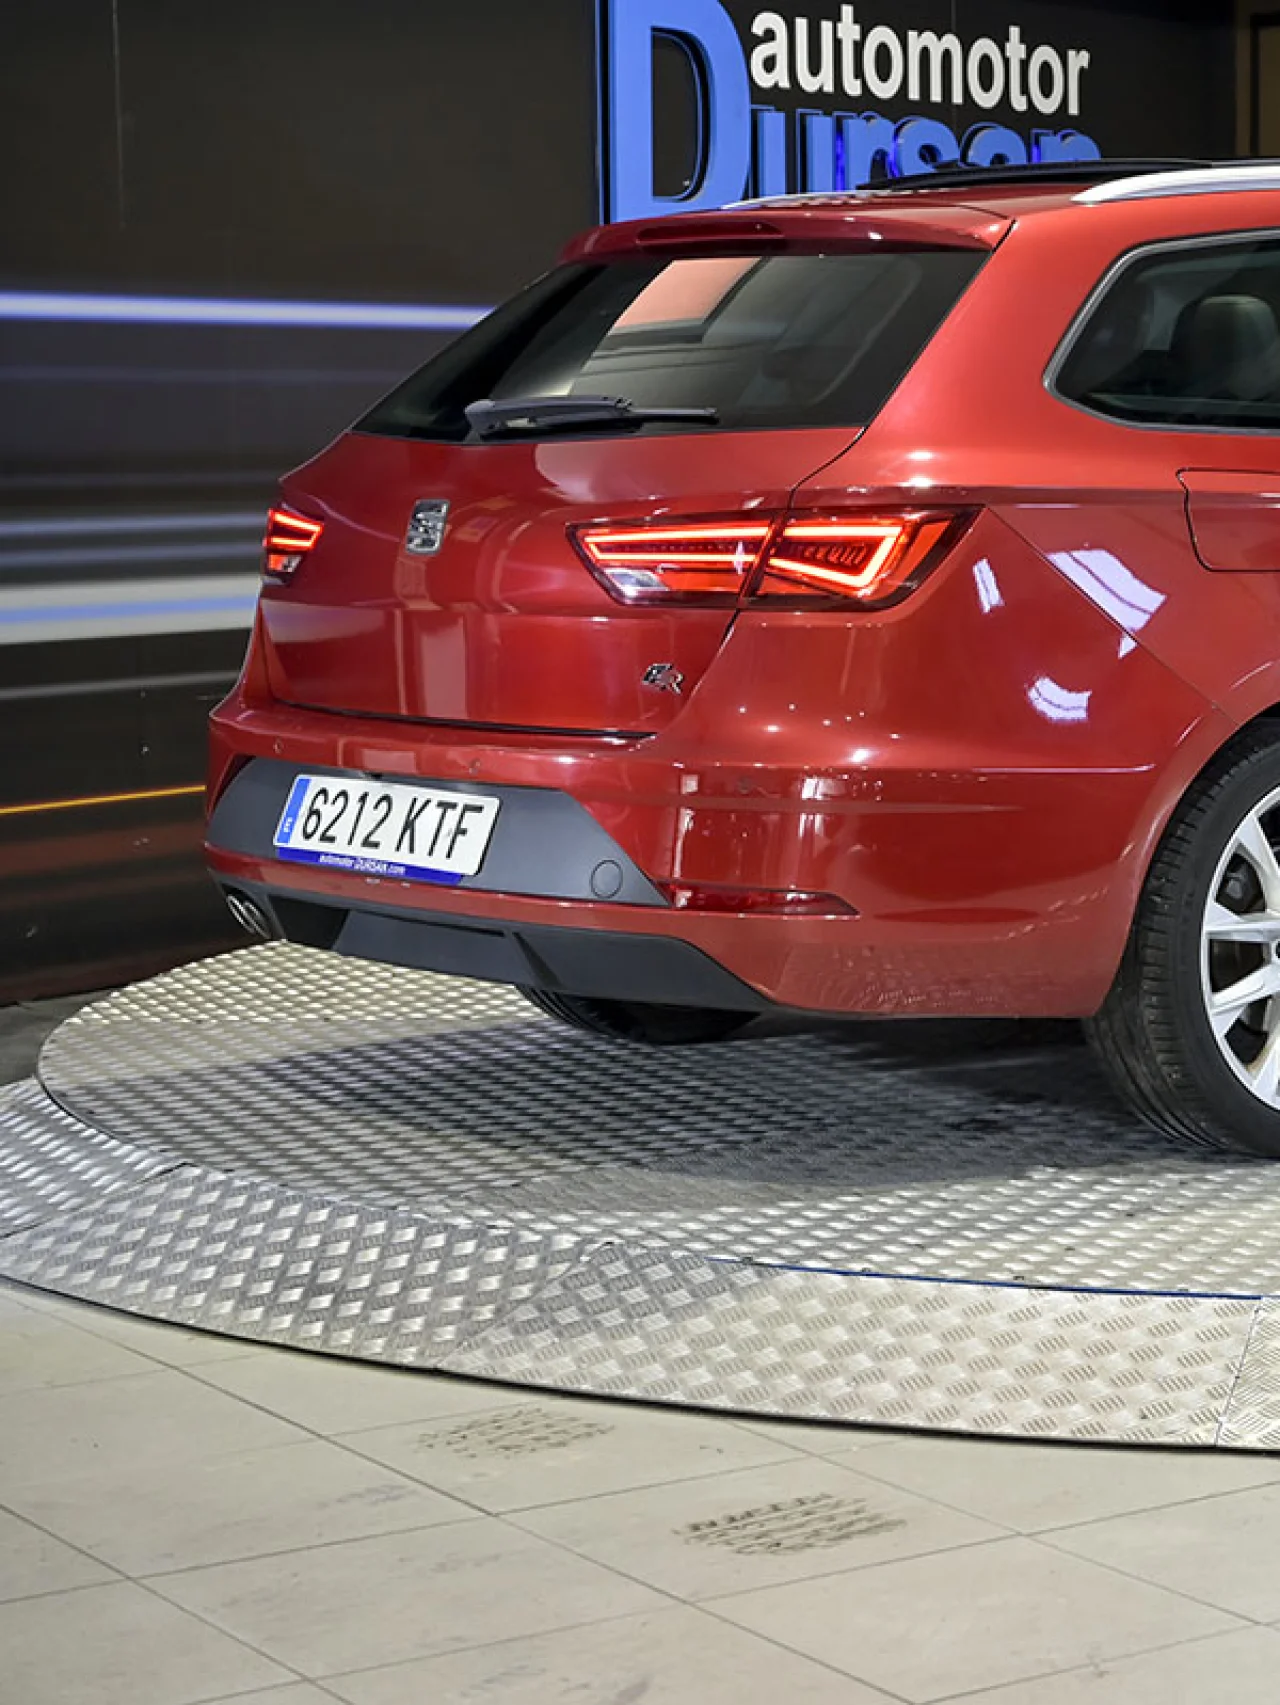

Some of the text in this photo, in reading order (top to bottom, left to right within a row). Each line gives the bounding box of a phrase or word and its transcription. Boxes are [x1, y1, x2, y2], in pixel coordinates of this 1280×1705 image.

[600, 0, 1101, 226] Durs
[751, 4, 1090, 115] automotor
[302, 787, 484, 860] 6212 KTF
